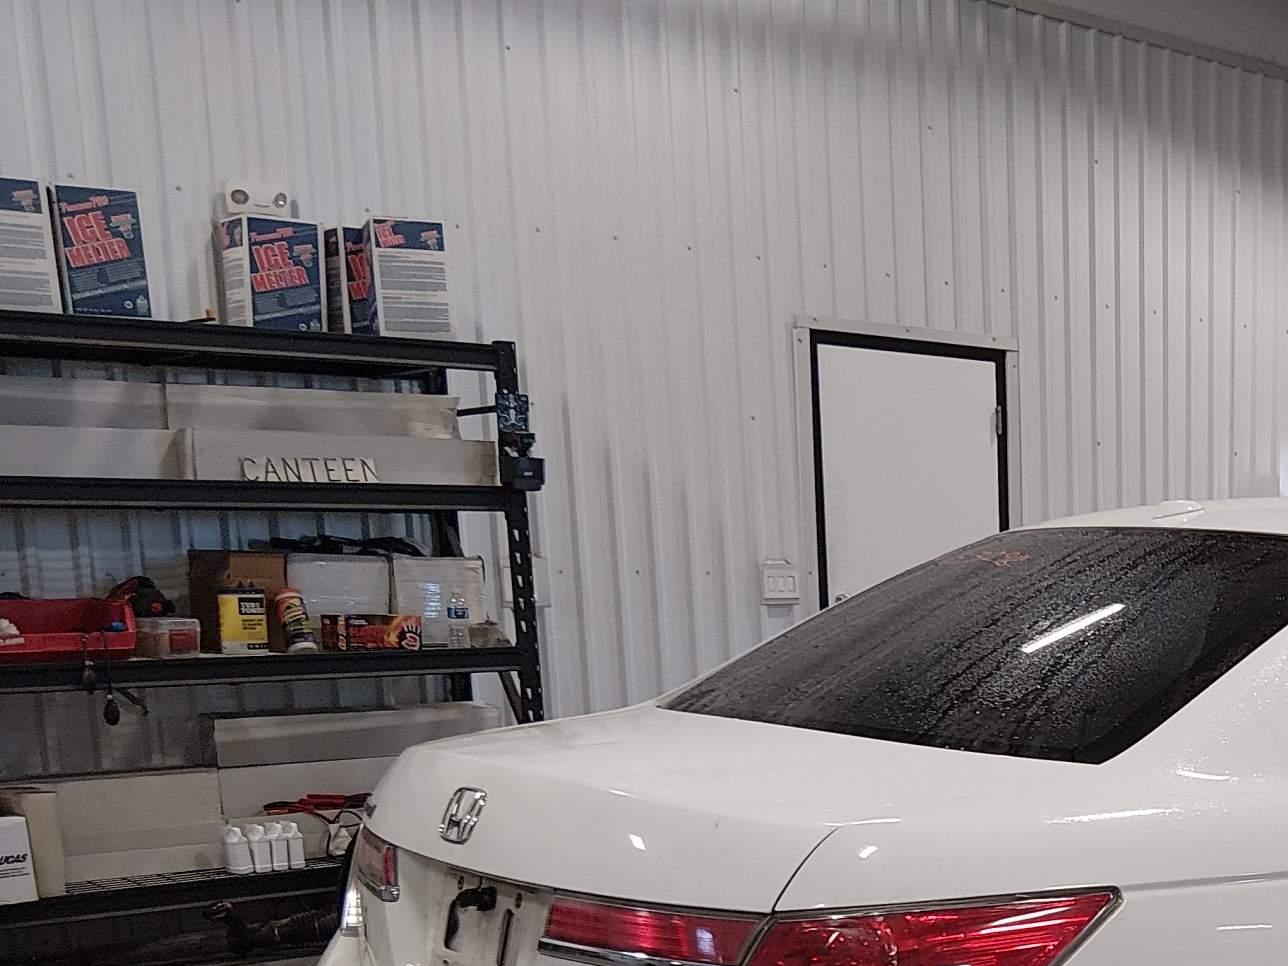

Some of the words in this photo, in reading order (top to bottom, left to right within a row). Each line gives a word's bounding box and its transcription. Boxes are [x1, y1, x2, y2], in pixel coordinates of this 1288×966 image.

[63, 211, 112, 246] ICE
[65, 238, 131, 268] MELTER
[252, 241, 294, 273] ICE
[251, 266, 310, 292] MELTER
[239, 457, 379, 481] CANTEEN
[0, 853, 28, 866] UCAS
